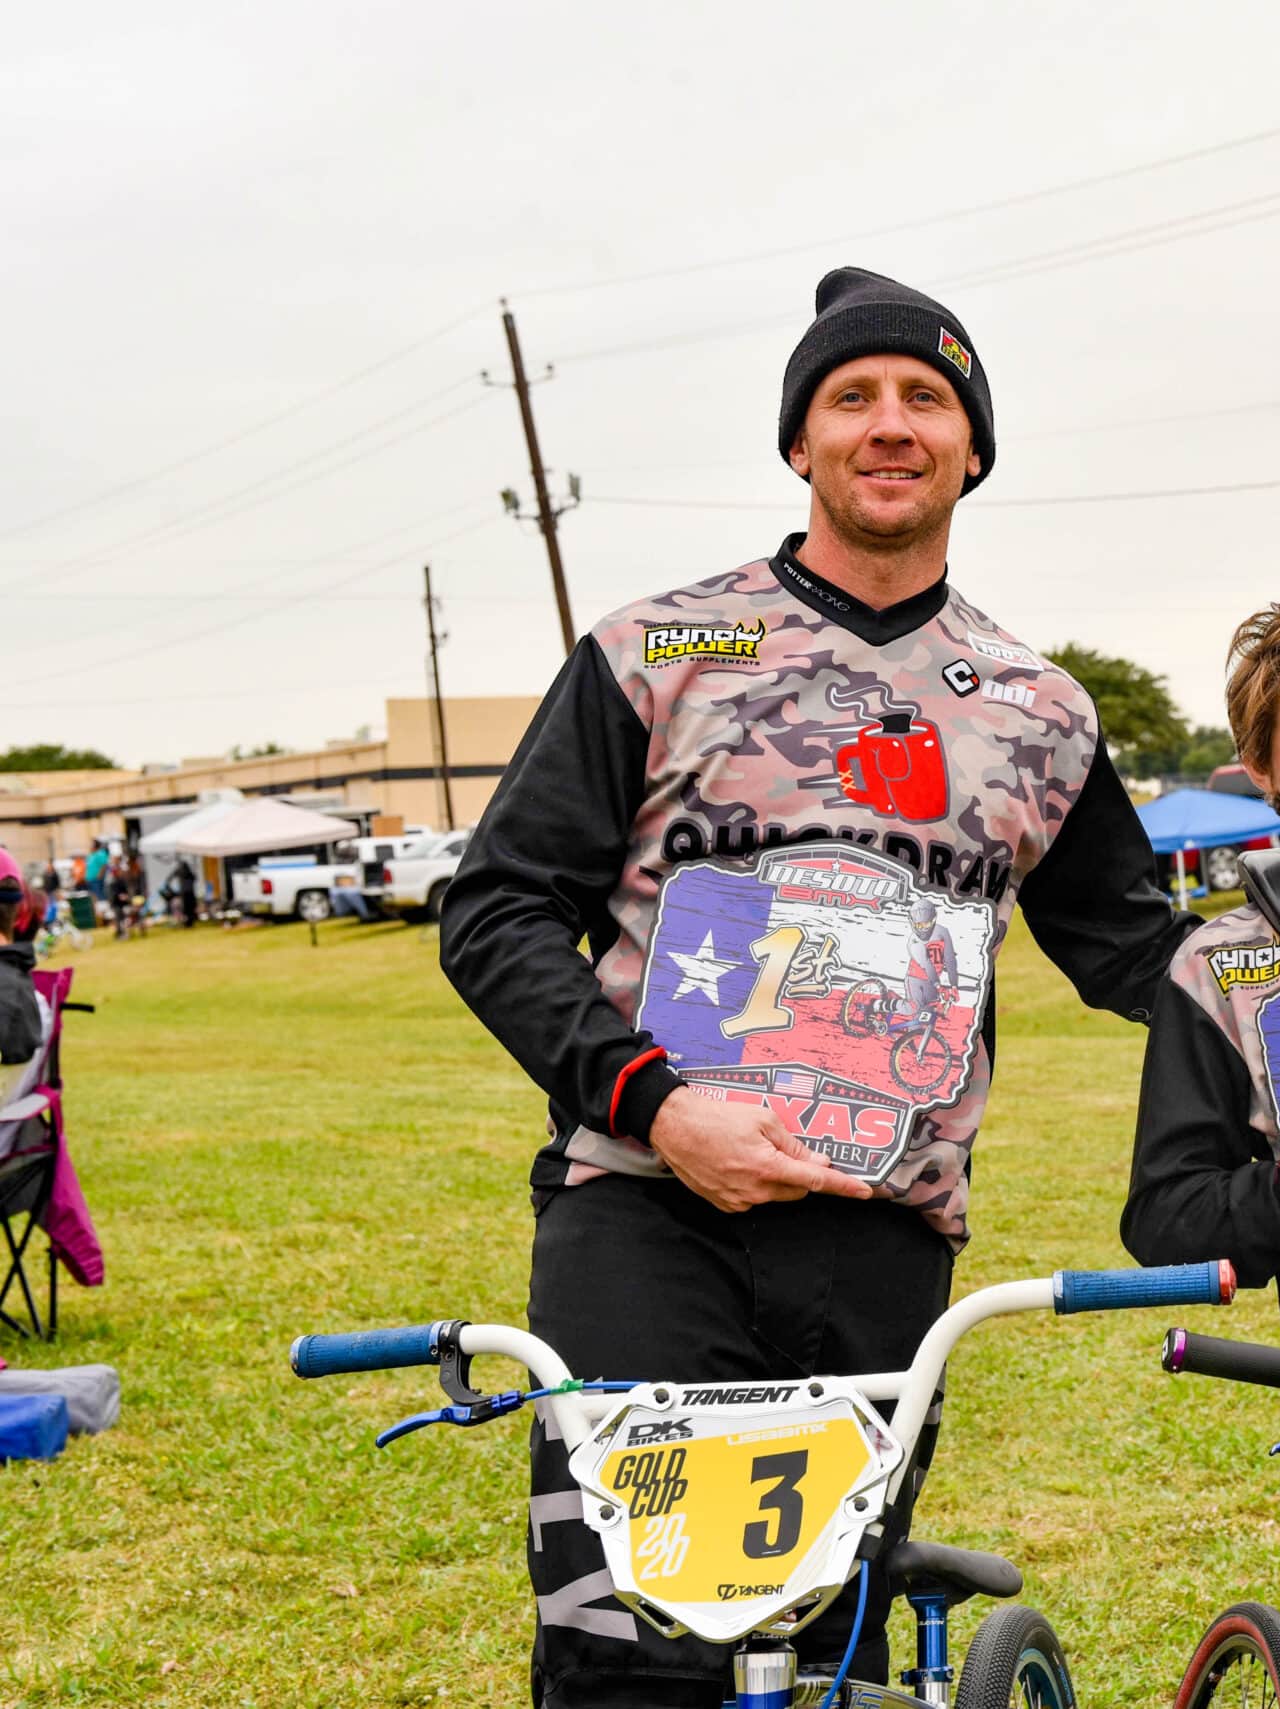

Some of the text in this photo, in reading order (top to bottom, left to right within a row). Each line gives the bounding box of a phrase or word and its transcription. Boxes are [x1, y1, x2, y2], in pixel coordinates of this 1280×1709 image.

[646, 640, 757, 662] POWER
[767, 864, 898, 899] DESOTO
[779, 885, 881, 911] BMX
[725, 1091, 898, 1149] XAS
[680, 1386, 800, 1407] TANGENT
[627, 1431, 693, 1447] BIKES
[629, 1417, 694, 1439] DK
[613, 1447, 687, 1490] GOLD
[629, 1478, 688, 1520] CUP
[744, 1449, 809, 1560] 3
[739, 1584, 785, 1596] TANGENT
